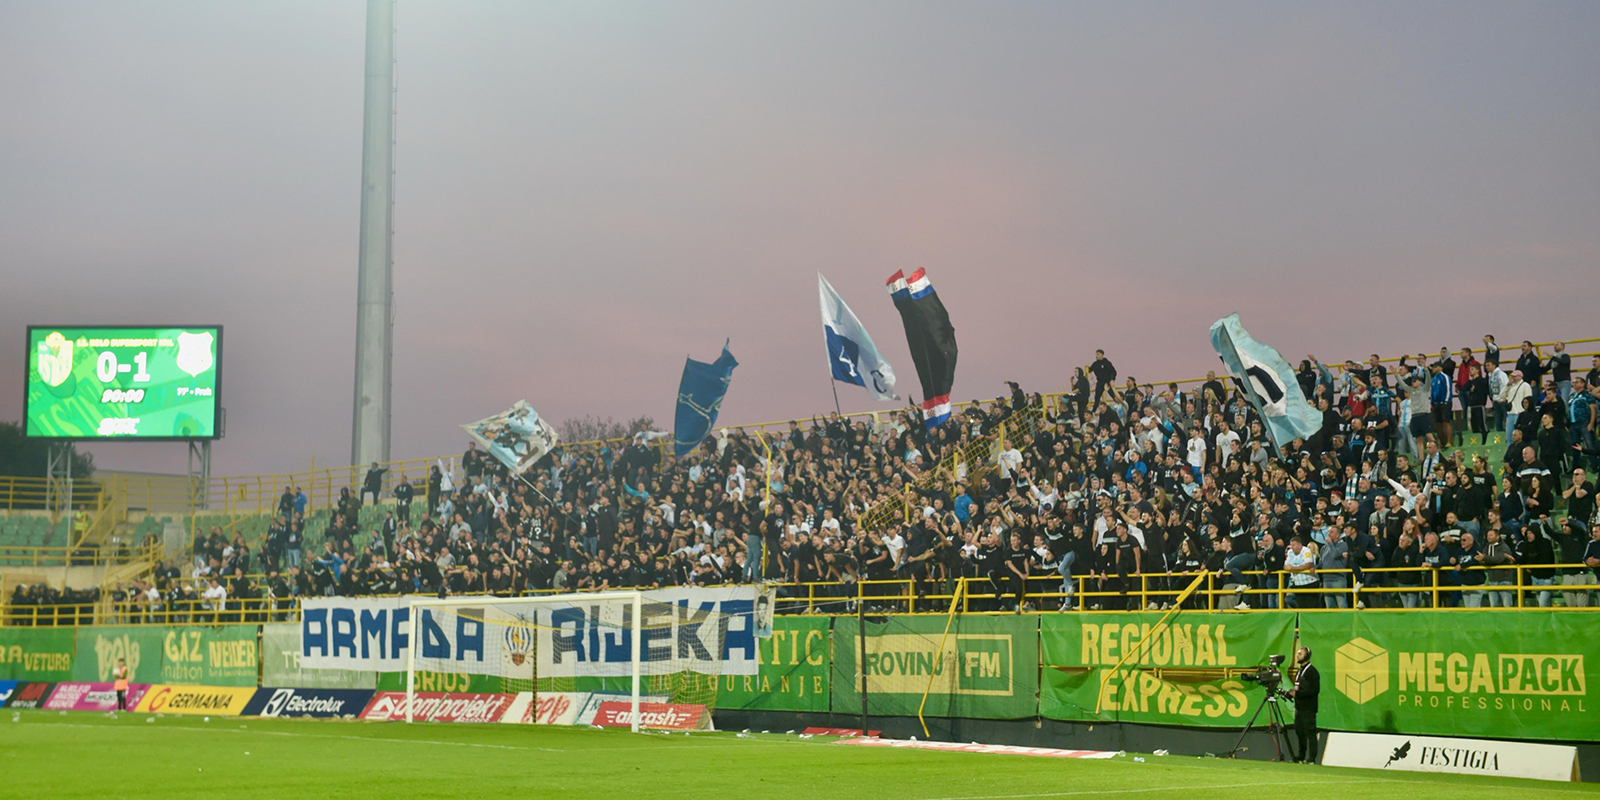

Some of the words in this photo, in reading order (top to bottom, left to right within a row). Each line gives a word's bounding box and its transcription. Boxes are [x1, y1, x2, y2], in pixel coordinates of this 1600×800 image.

[97, 351, 150, 382] 0-1
[101, 389, 145, 403] 90:00
[303, 607, 485, 662] ARMADA
[551, 599, 755, 663] RIJEKA
[165, 631, 203, 662] GAZ
[1081, 623, 1236, 666] REGIONAL
[23, 653, 70, 671] VETURA
[865, 651, 943, 676] ROVINJ
[965, 651, 1000, 677] FM
[169, 693, 233, 708] GERMANIA
[286, 695, 345, 712] Electrolux
[1100, 669, 1248, 717] EXPRESS
[1398, 694, 1586, 712] PROFESSIONAL
[394, 692, 506, 722] domprojekt
[615, 707, 677, 726] aicash
[1420, 746, 1499, 770] FESTIGIA
